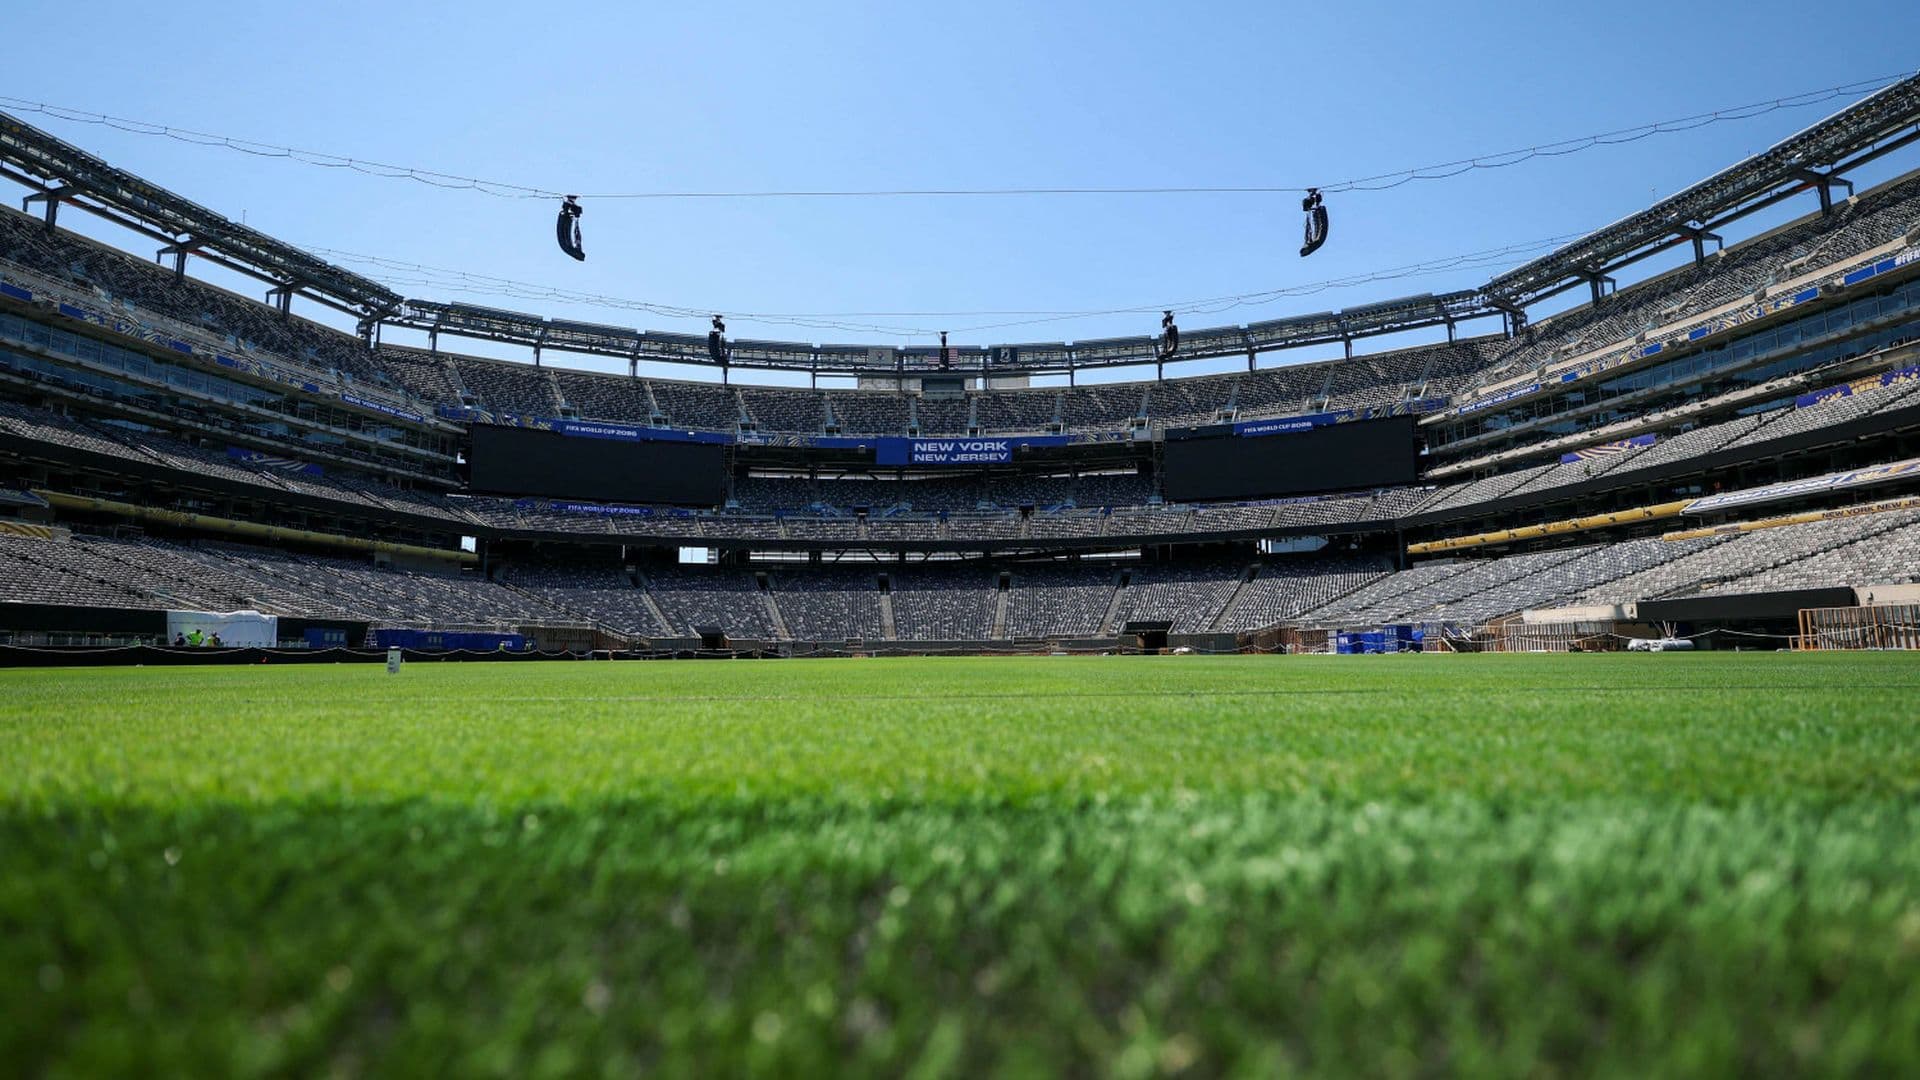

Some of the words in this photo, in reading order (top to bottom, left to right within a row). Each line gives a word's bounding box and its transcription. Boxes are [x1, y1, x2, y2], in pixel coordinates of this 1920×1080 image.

[580, 426, 602, 434] WORLD
[914, 443, 954, 452] NEW
[959, 441, 1008, 452] YORK
[950, 453, 1008, 461] JERSEY
[1822, 510, 1844, 518] NEW
[1846, 506, 1873, 515] YORK
[1876, 502, 1901, 511] NEW
